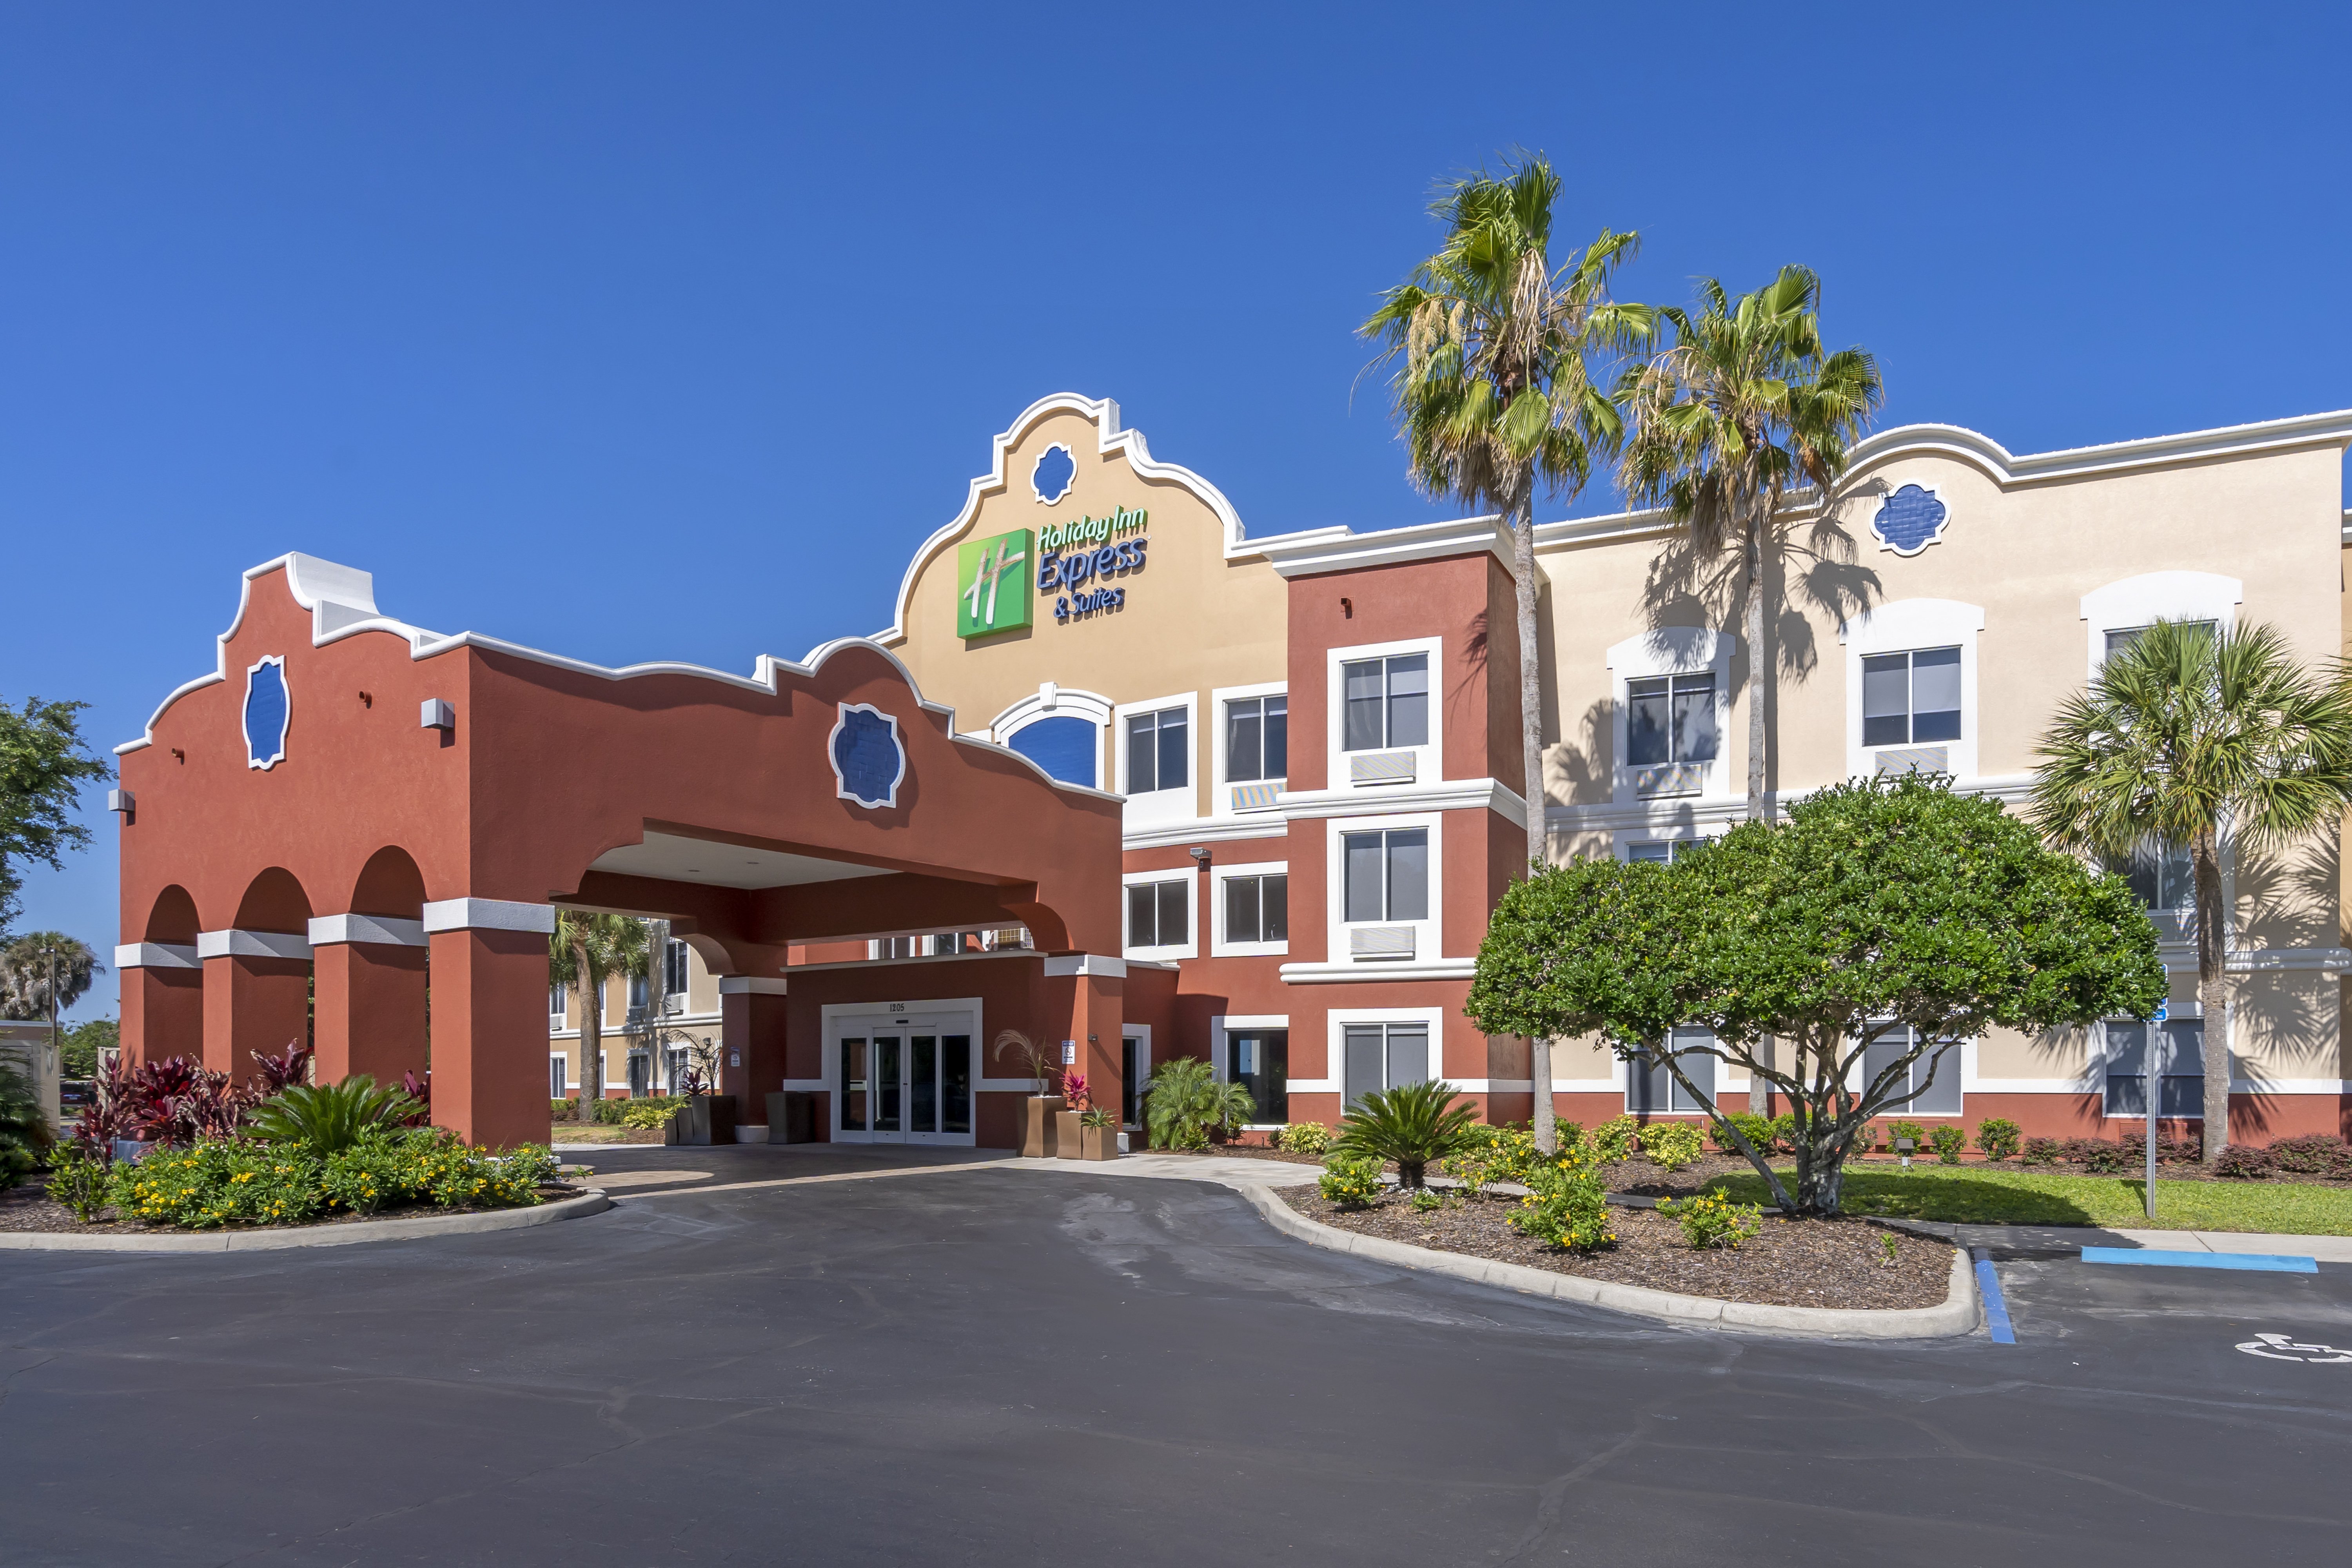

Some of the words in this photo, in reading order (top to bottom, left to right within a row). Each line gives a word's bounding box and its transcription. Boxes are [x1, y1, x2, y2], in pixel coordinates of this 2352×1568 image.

[1036, 515, 1113, 551] Holiday
[1113, 505, 1147, 532] Inn
[1037, 538, 1145, 592] Express
[1053, 596, 1069, 619] &
[1069, 587, 1124, 615] Suites
[890, 1003, 904, 1012] 1205
